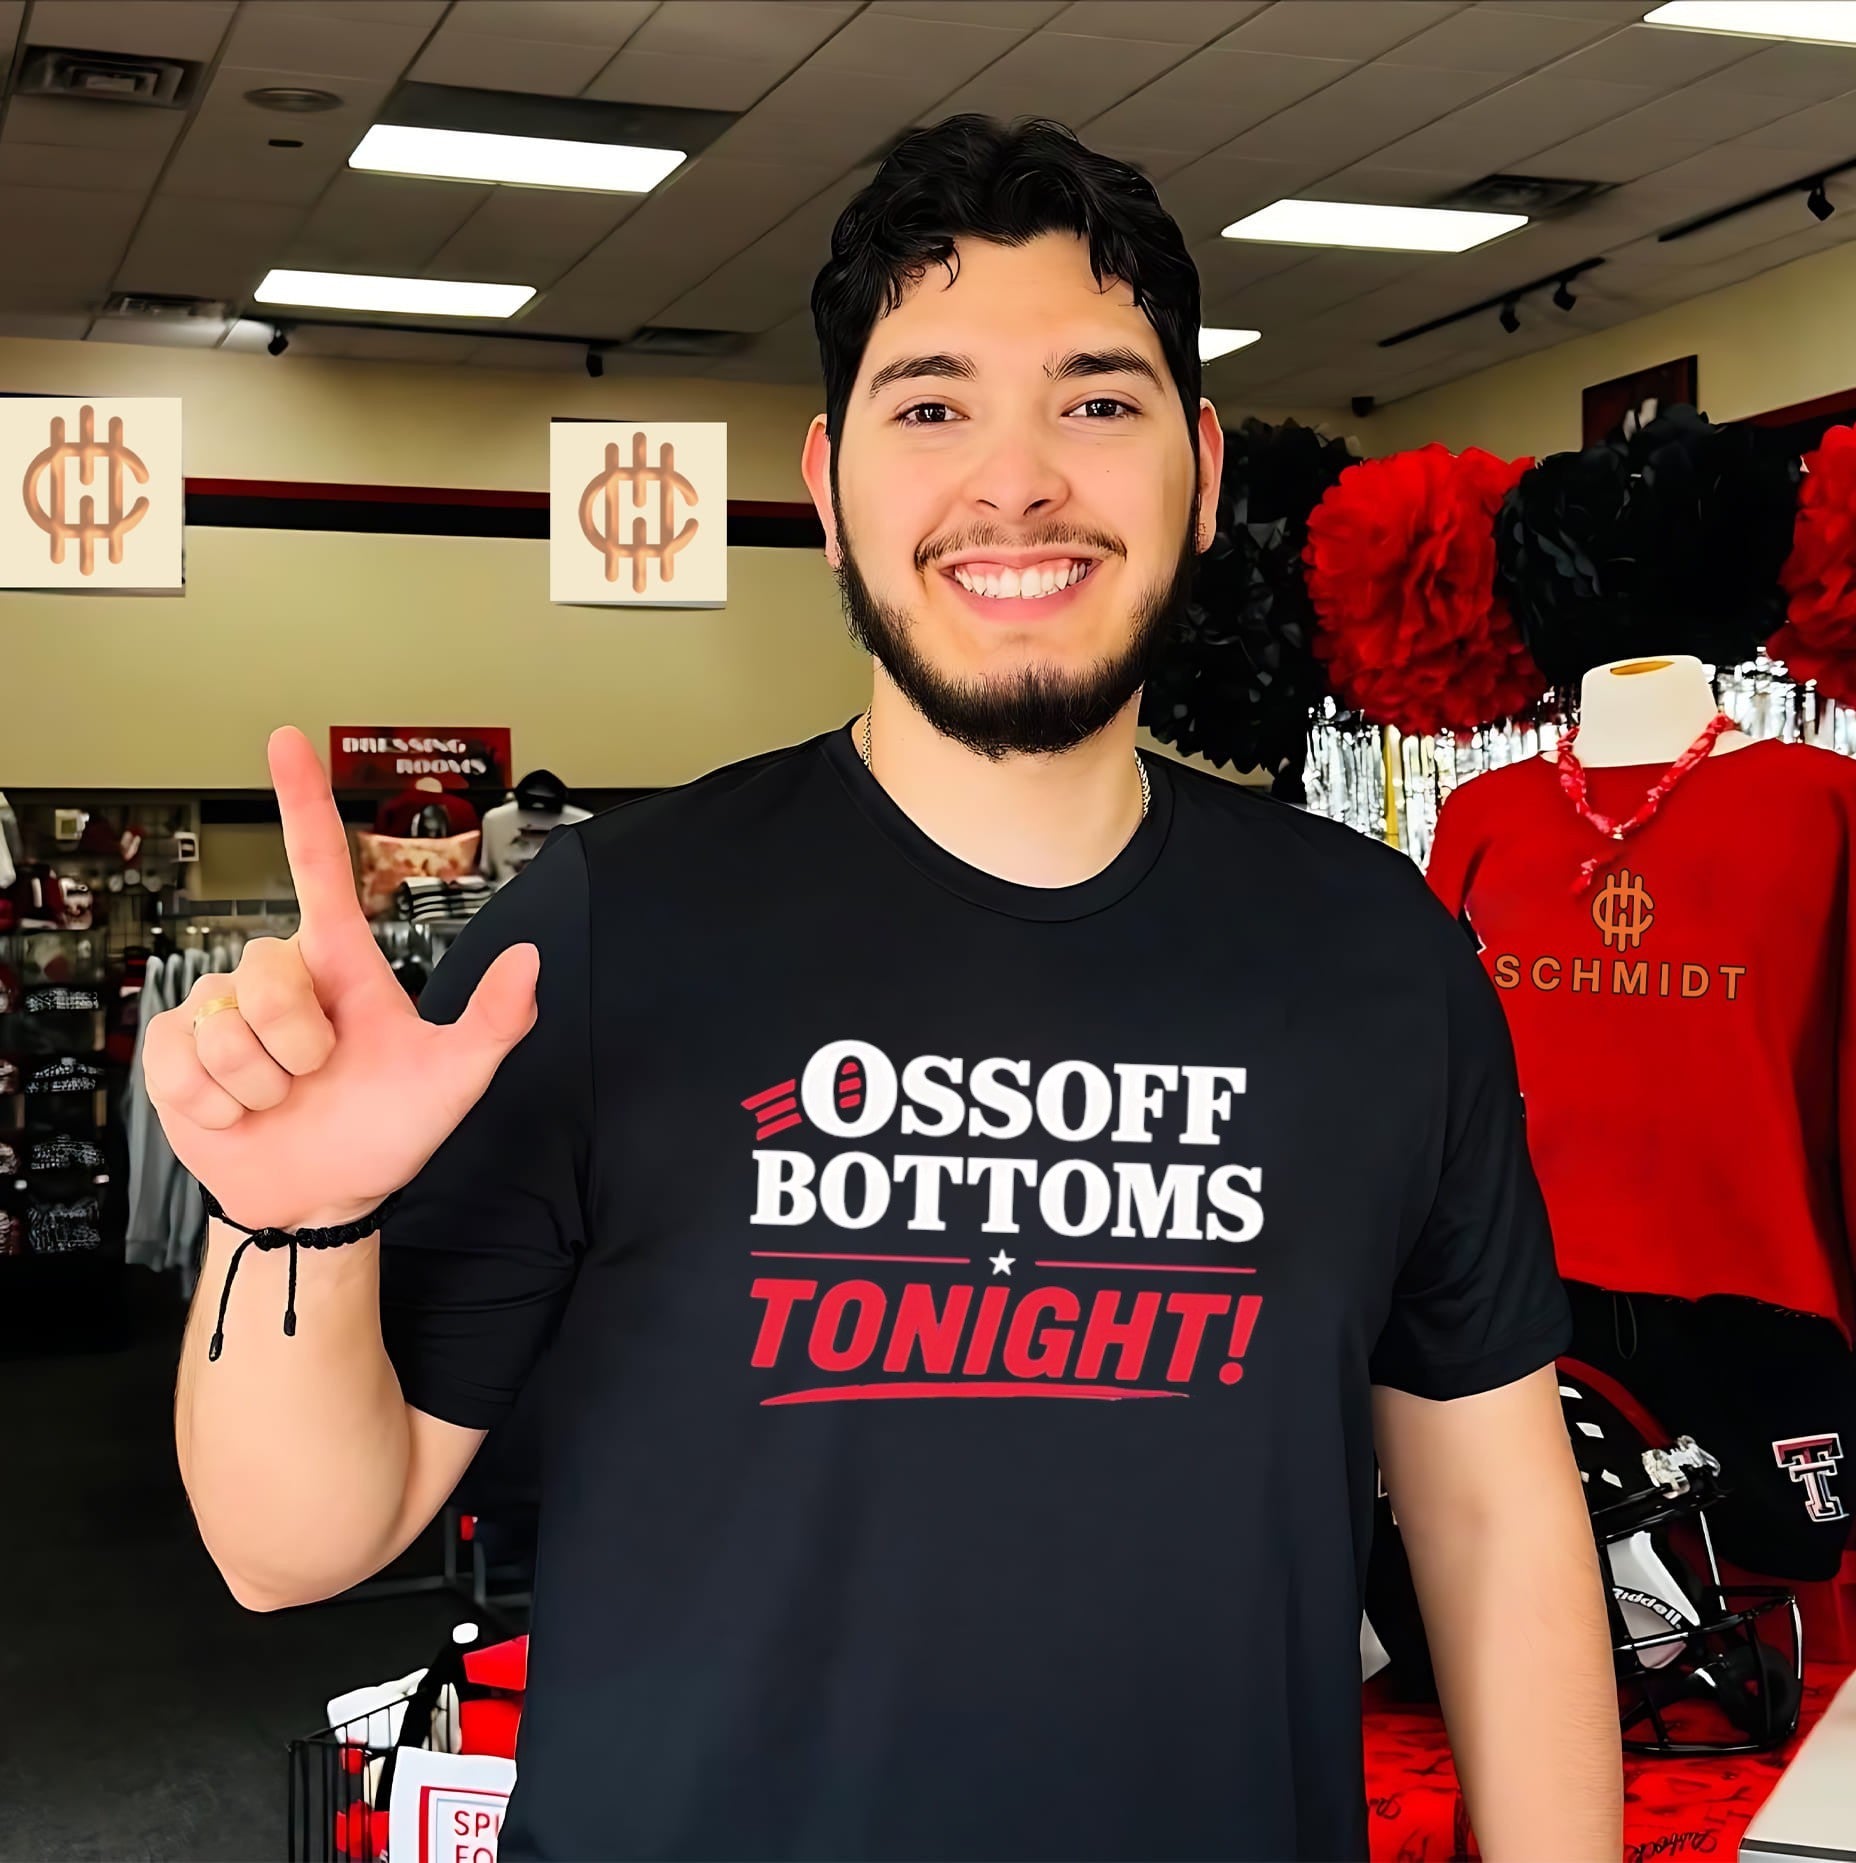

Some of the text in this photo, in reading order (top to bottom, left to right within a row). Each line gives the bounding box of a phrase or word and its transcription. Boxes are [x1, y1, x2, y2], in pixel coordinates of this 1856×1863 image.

[342, 737, 467, 754] DRESSING
[396, 758, 487, 775] ROOMS
[1494, 953, 1747, 1000] SCHMIDT
[801, 1039, 1247, 1145] OSSOFF
[750, 1150, 1264, 1243] BOTTOMS
[750, 1278, 1264, 1385] TONIGHT!
